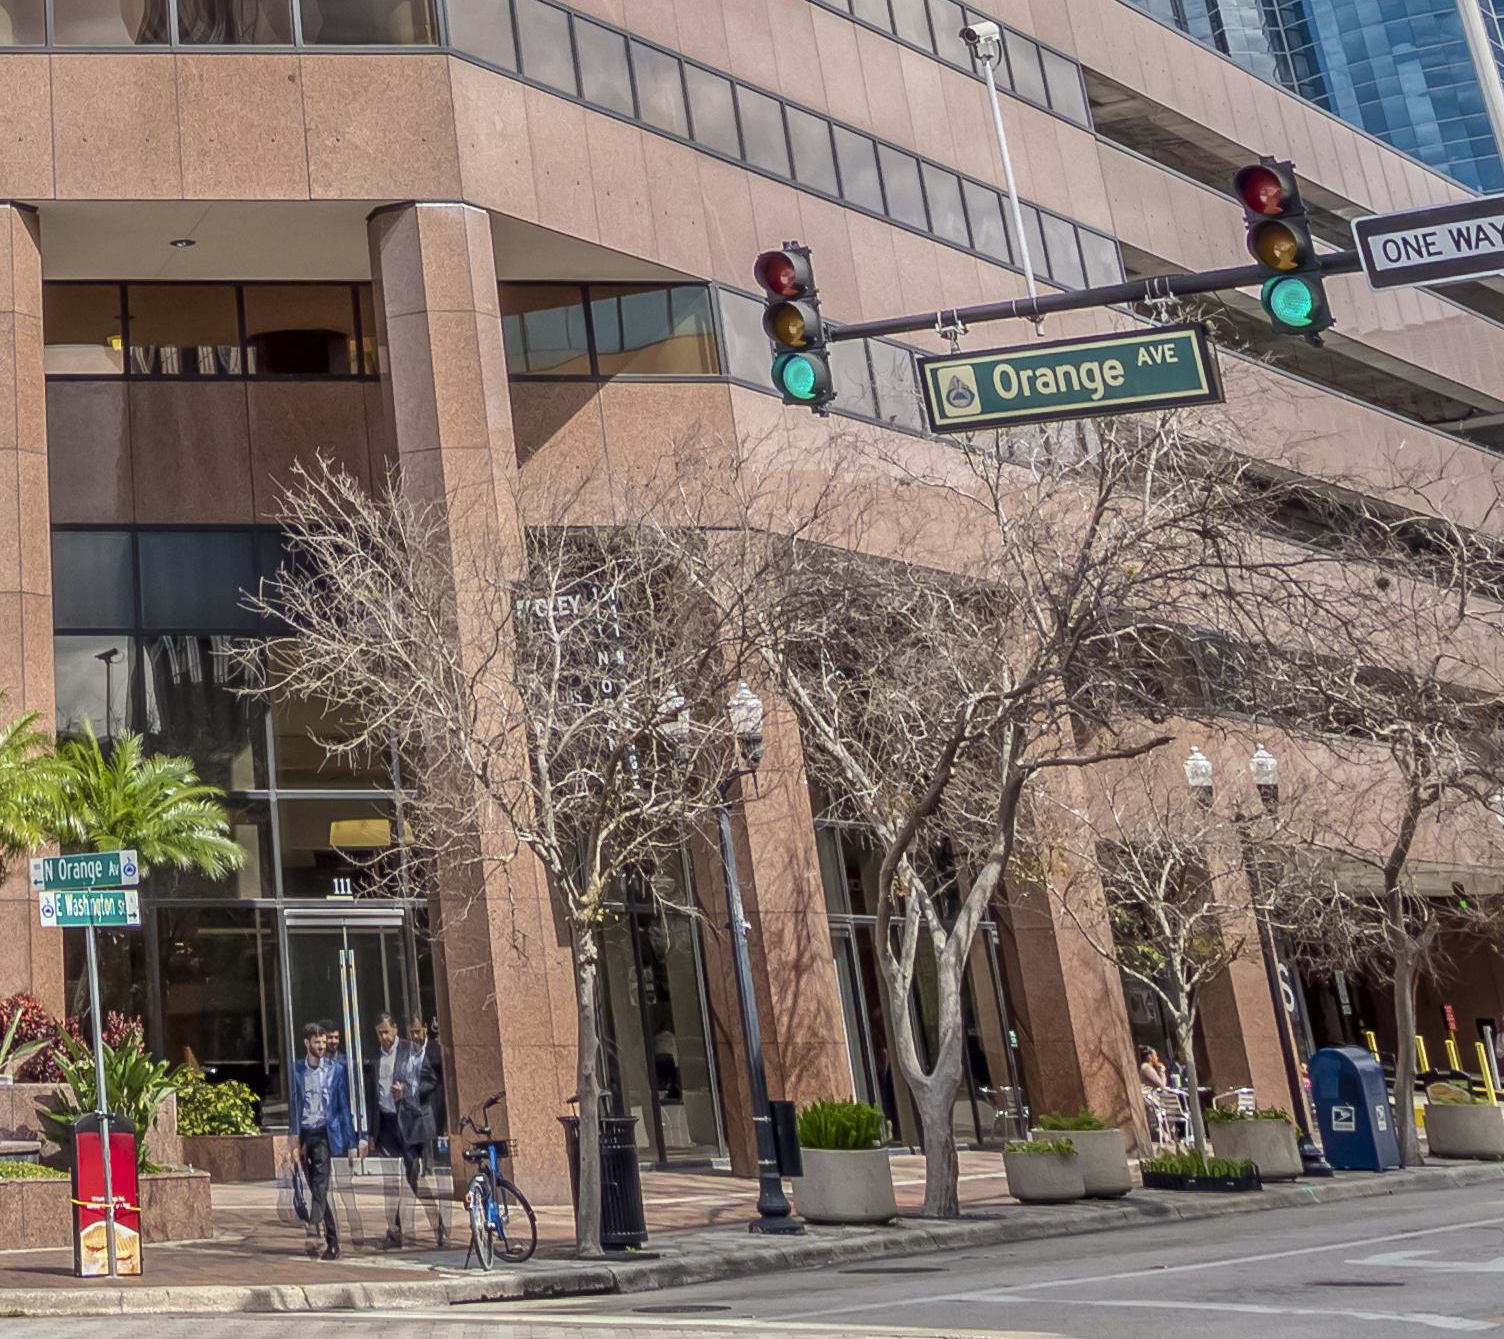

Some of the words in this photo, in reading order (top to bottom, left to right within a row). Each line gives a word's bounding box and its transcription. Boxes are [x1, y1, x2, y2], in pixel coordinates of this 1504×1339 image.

[1382, 231, 1444, 263] ONE
[993, 358, 1126, 401] Orange
[1137, 343, 1179, 367] AVE
[44, 860, 53, 881] N
[58, 858, 102, 885] Orange
[108, 861, 119, 877] Av
[333, 877, 352, 895] 111
[55, 894, 63, 916] E
[65, 893, 115, 922] Washngton
